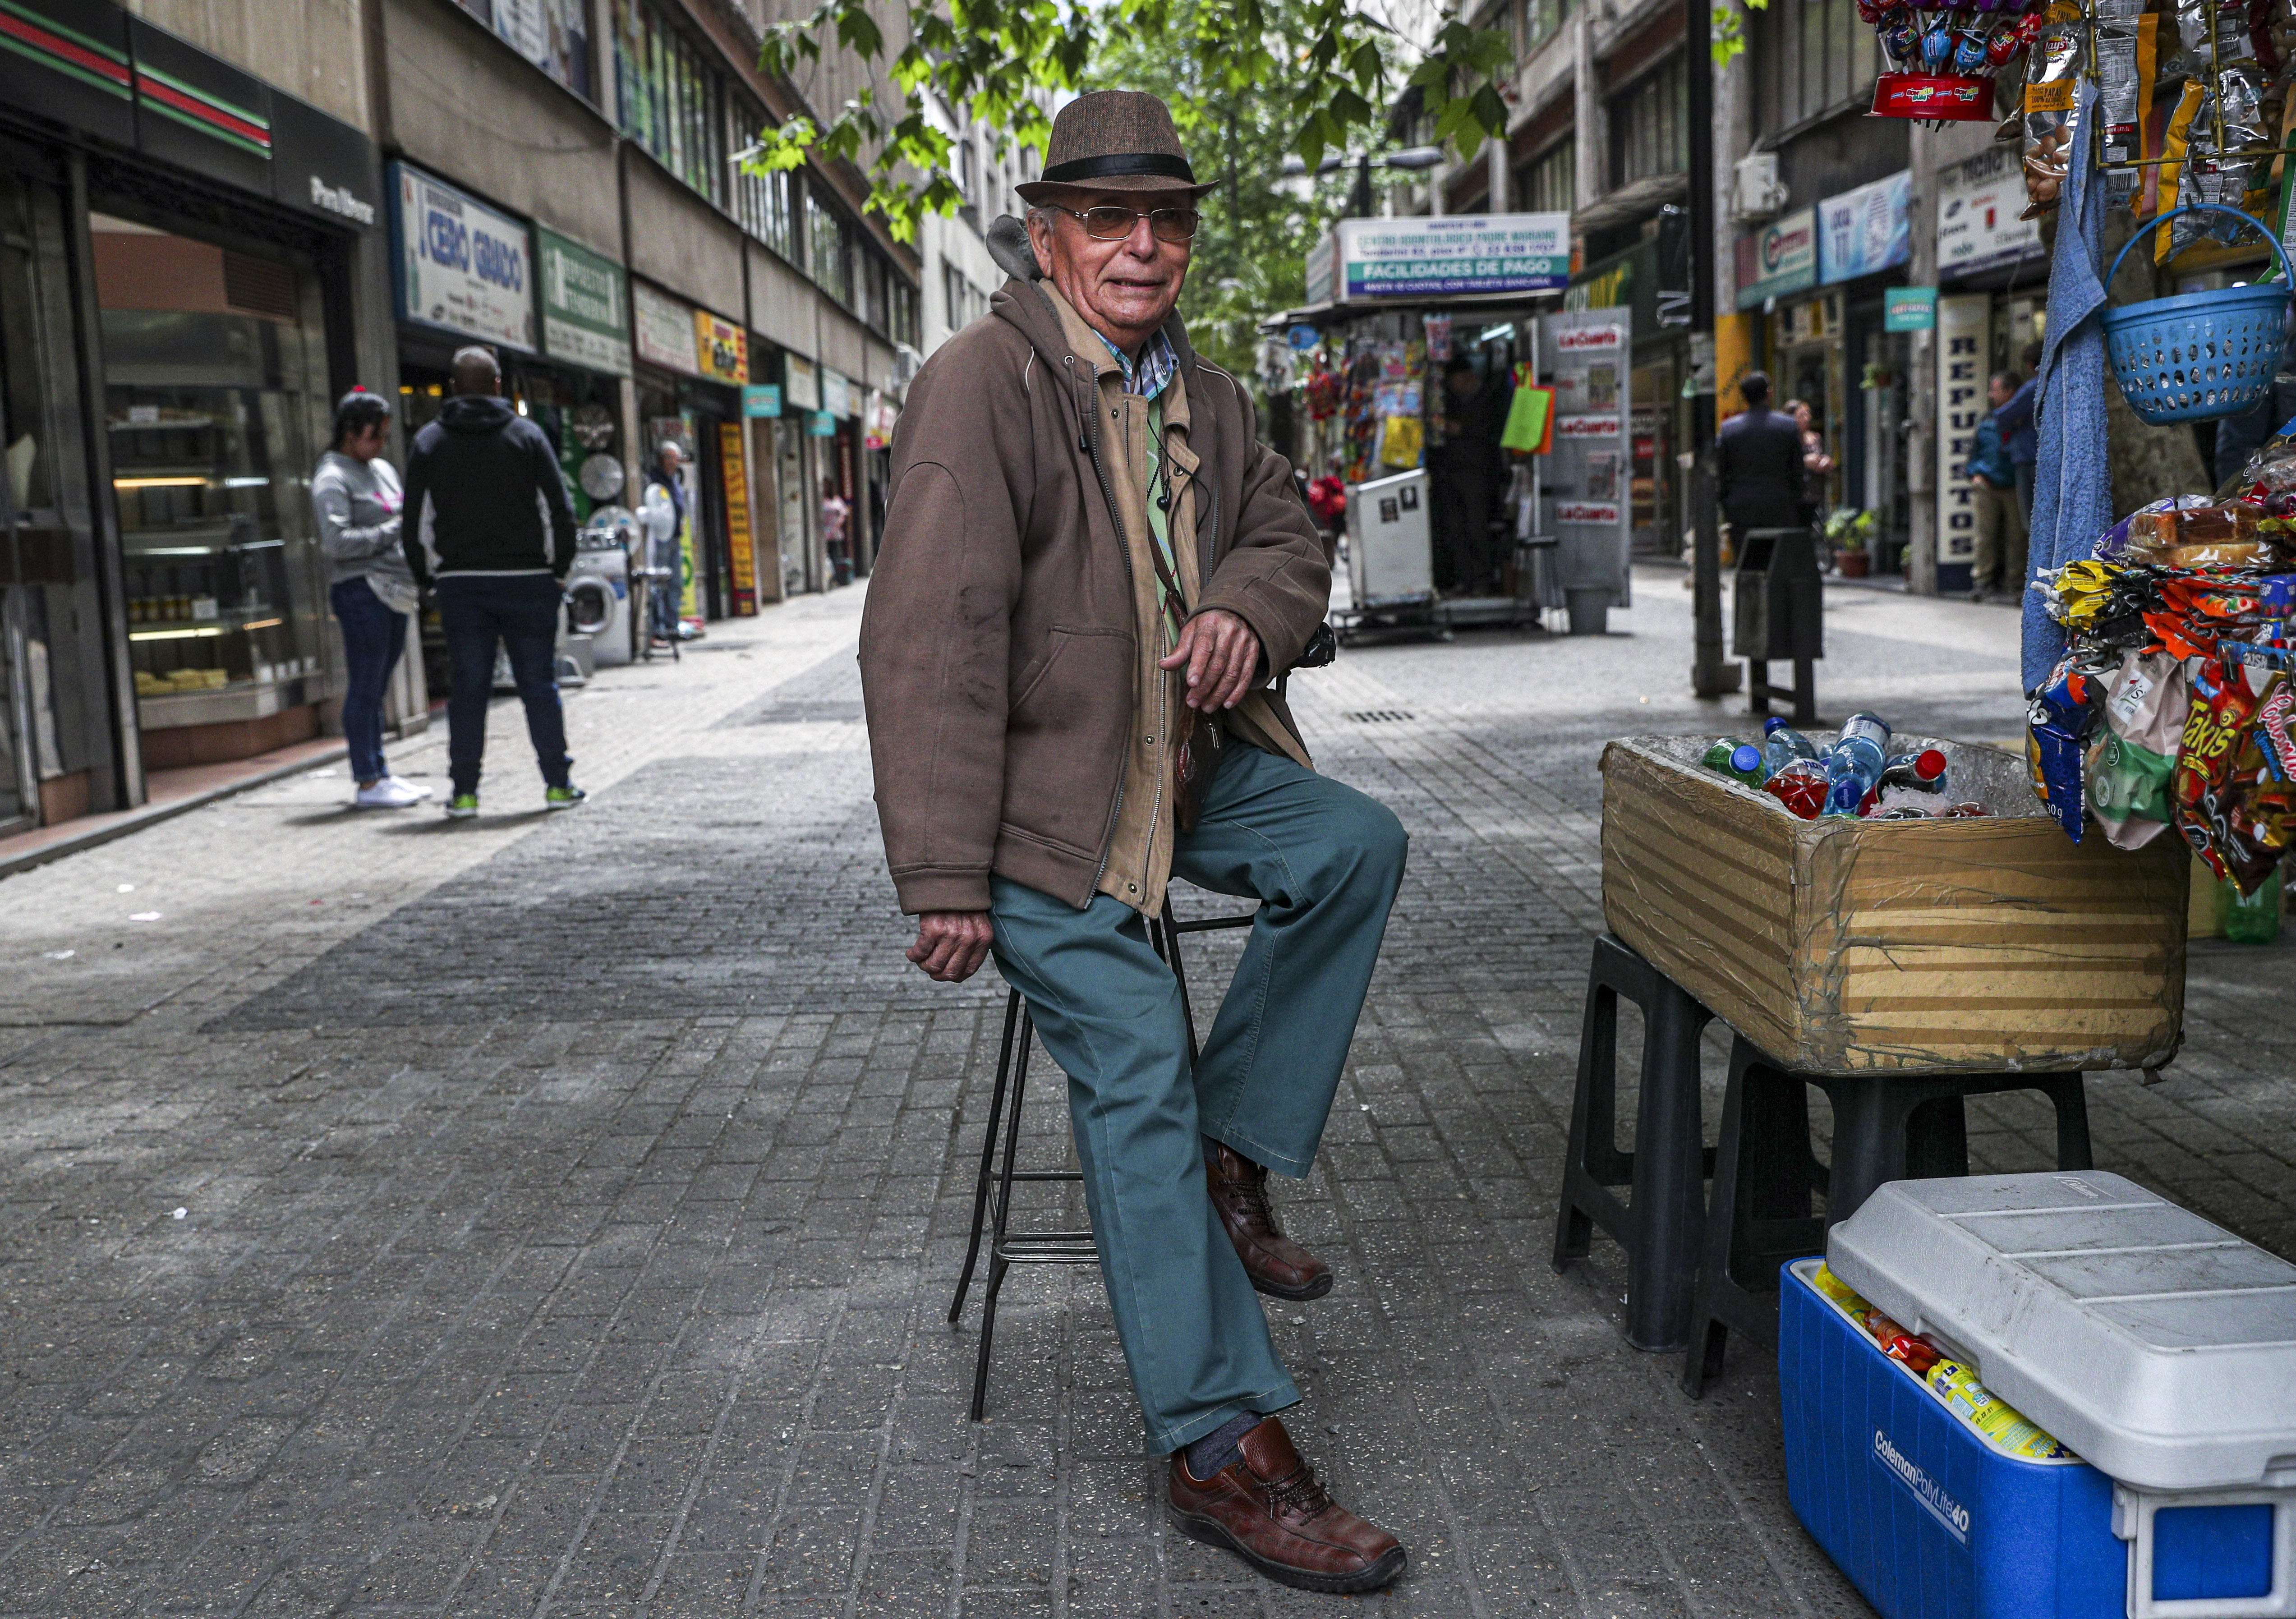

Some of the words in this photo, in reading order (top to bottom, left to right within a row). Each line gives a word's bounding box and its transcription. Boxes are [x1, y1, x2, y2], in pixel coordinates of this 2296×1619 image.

[2044, 41, 2066, 54] Lay's
[2044, 87, 2062, 97] PAPAS
[1362, 260, 1473, 279] FACILIDADES
[1476, 259, 1500, 276] DE
[1503, 258, 1552, 275] PAGO
[1949, 337, 1977, 555] REPUESTOS
[2057, 808, 2062, 819] g
[2034, 1439, 2053, 1457] sabor
[1875, 1430, 1916, 1484] Coleman
[1915, 1467, 1953, 1518] PolyLite
[1951, 1504, 1969, 1532] 40
